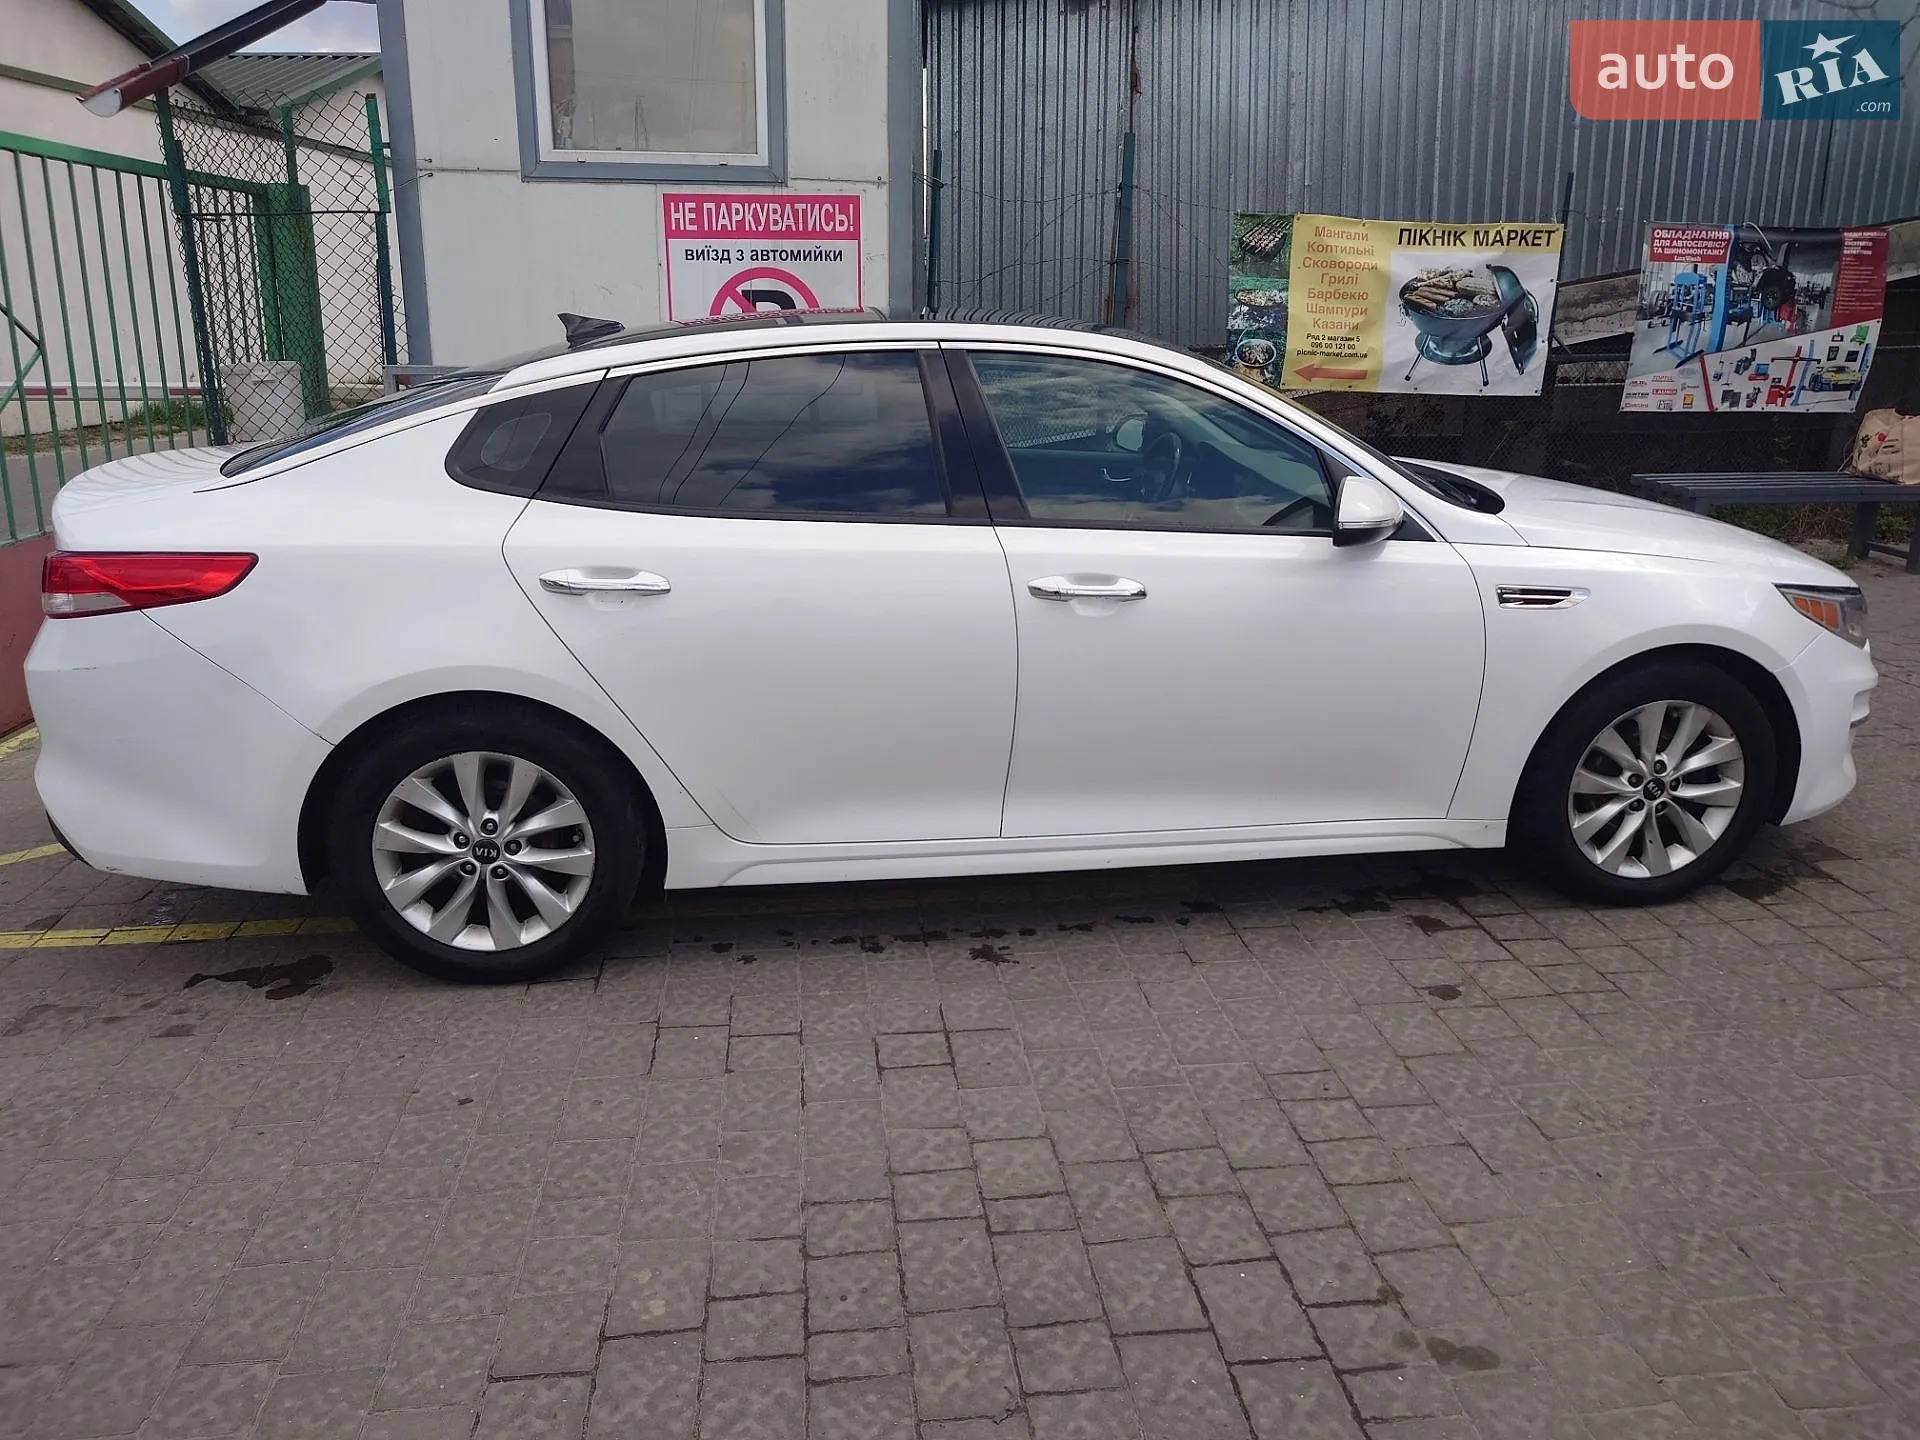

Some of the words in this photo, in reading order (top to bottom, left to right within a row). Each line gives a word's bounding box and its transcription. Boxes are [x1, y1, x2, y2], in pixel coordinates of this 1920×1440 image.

[669, 202, 698, 232] НЕ
[702, 202, 855, 233] ПАРКУВАТИСЬ!
[1314, 225, 1369, 241] Мангали
[1397, 228, 1467, 247] ПІКНІК
[1472, 229, 1557, 247] МАРКЕТ
[1653, 229, 1729, 240] ОБЛАДНАННЯ
[1306, 241, 1375, 256] Коптильні
[1653, 239, 1670, 247] ДЛЯ
[1671, 240, 1727, 248] АВТОСЕРВІСУ
[684, 245, 732, 264] виїзд
[735, 249, 745, 262] з
[749, 246, 843, 263] автомийки
[1302, 257, 1378, 272] Сковороди
[1321, 273, 1359, 286] Грилі
[1307, 287, 1369, 302] Барбекю
[1306, 302, 1368, 318] Шампури
[1312, 317, 1360, 330] Казани
[1306, 333, 1320, 341] Ряд
[1647, 781, 1662, 798] KIA
[475, 847, 497, 858] KIA
